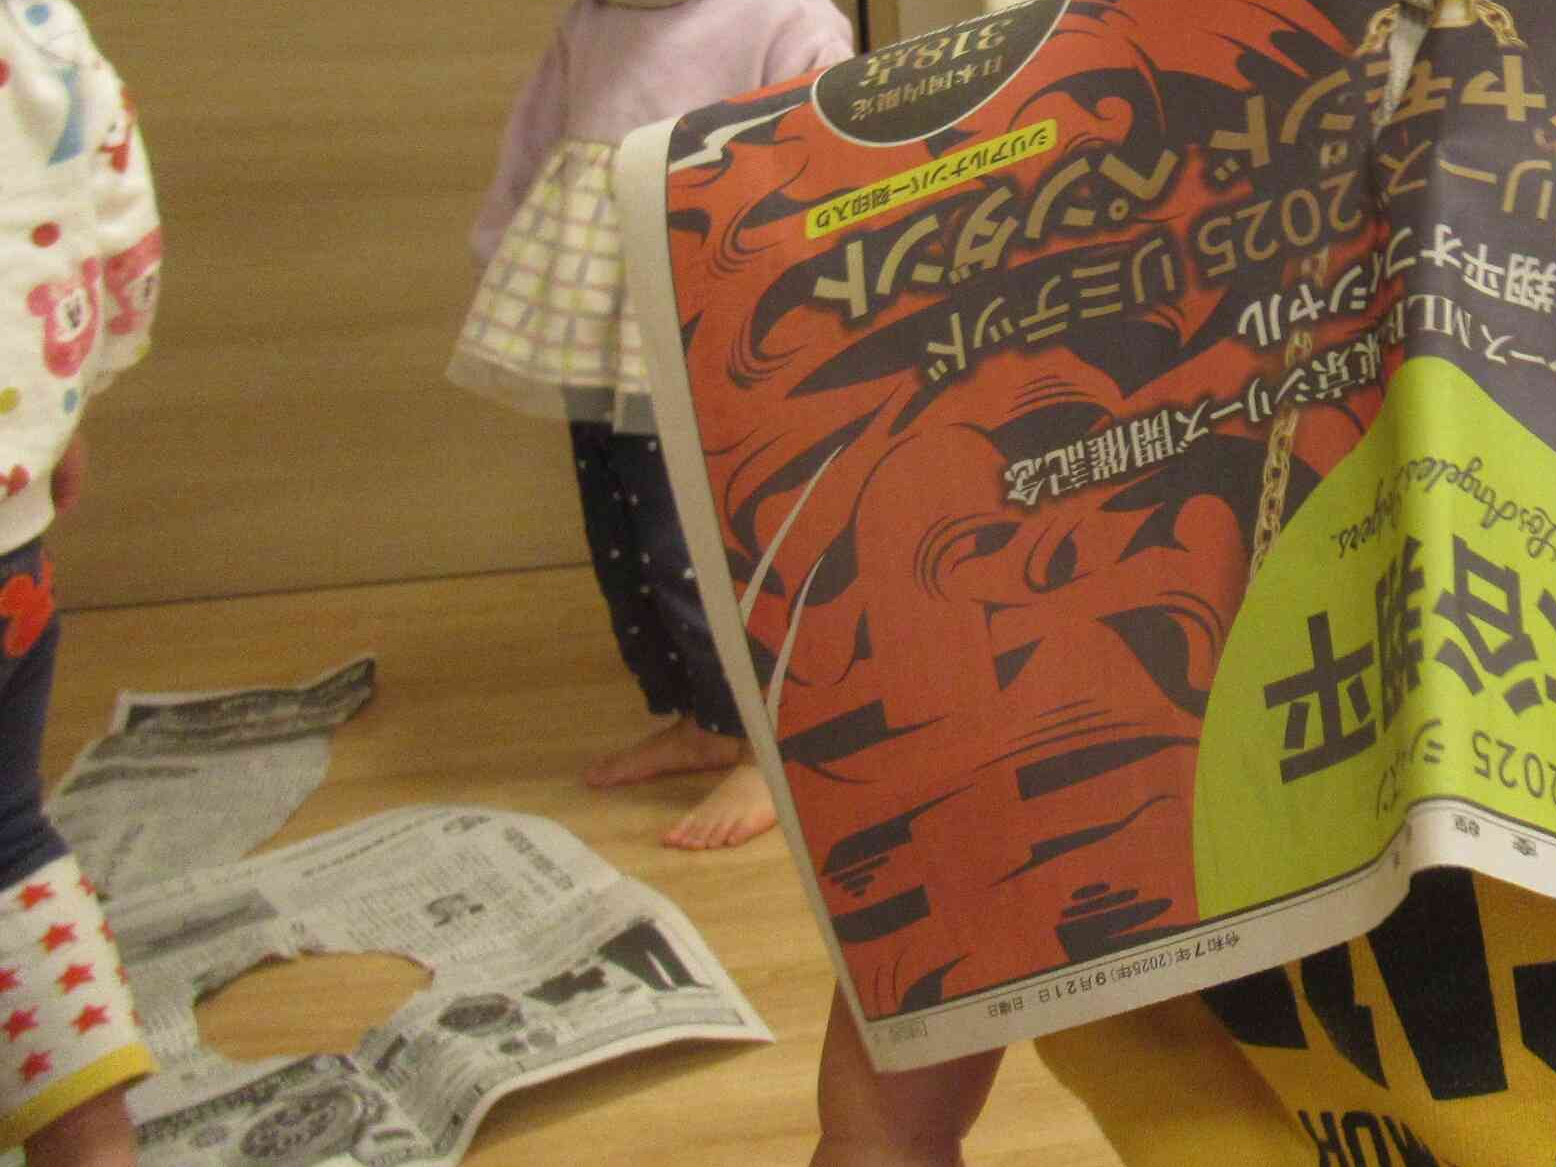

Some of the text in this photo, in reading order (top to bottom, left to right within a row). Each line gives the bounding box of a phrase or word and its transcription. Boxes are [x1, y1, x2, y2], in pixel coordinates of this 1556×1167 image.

[813, 150, 1179, 320] ペンダント
[816, 128, 1048, 228] シリアルナンバー刻印入り
[1195, 168, 1361, 276] 2025
[927, 237, 1175, 382] リミテッド
